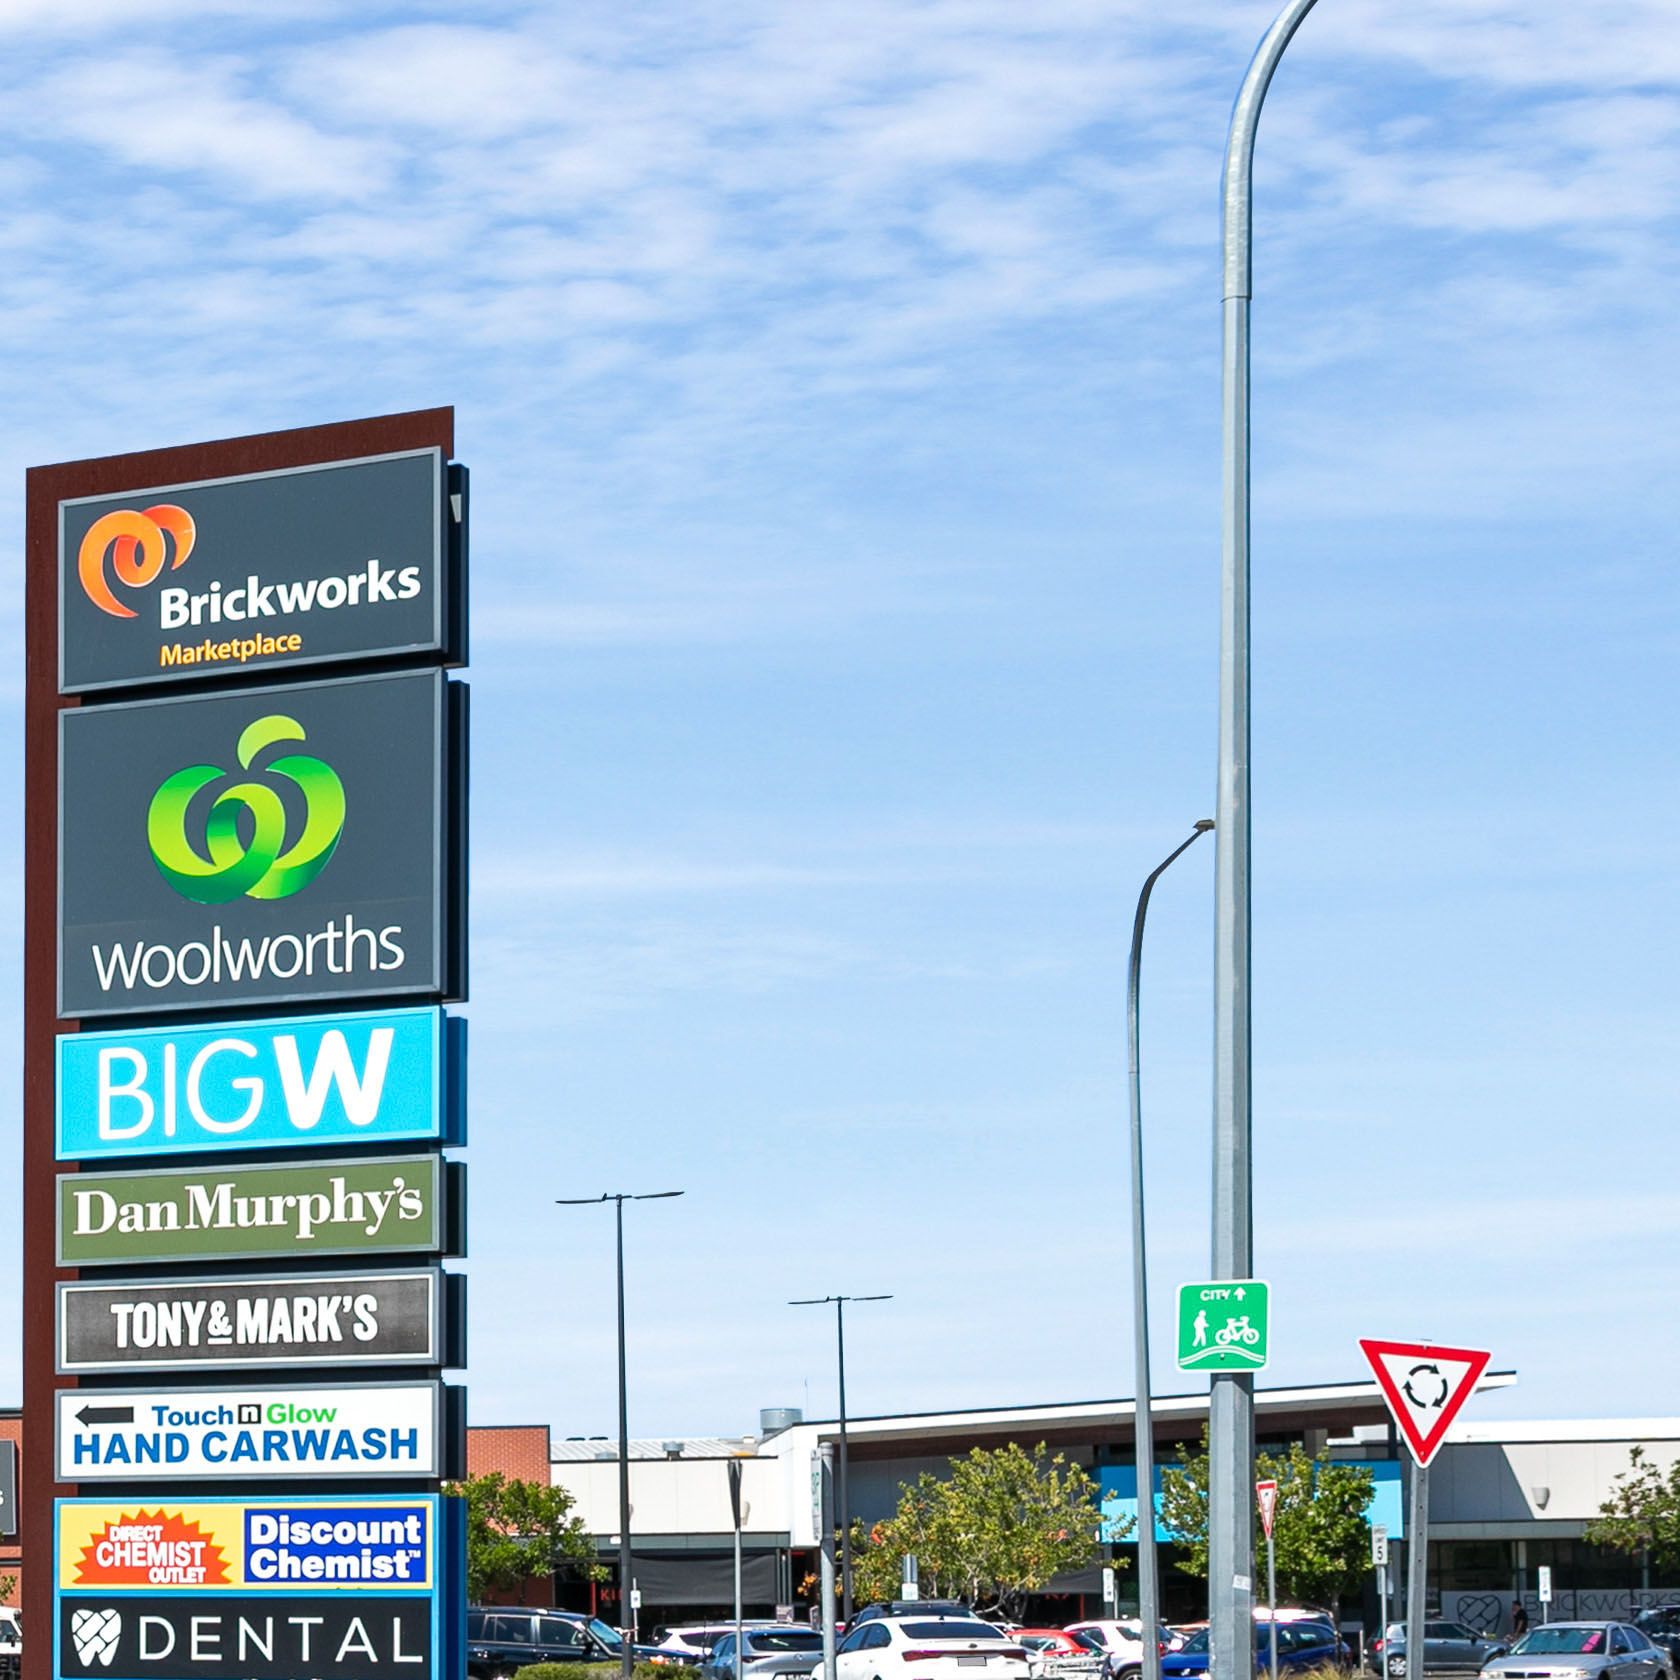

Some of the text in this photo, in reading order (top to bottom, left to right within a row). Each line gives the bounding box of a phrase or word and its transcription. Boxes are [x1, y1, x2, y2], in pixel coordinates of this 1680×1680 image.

[159, 559, 422, 629] Brickworks
[159, 632, 303, 667] Marketplace
[91, 913, 406, 992] Woolworths
[1200, 1289, 1231, 1301] CITY
[151, 1403, 234, 1427] Touch
[266, 1403, 338, 1425] Glow
[73, 1427, 419, 1465] HAND CARWASH
[108, 1524, 164, 1543] DIRECT
[249, 1514, 423, 1546] Discount
[95, 1540, 207, 1569] CHEMIST
[147, 1566, 207, 1584] OUTLET
[138, 1615, 424, 1664] DENTAL
